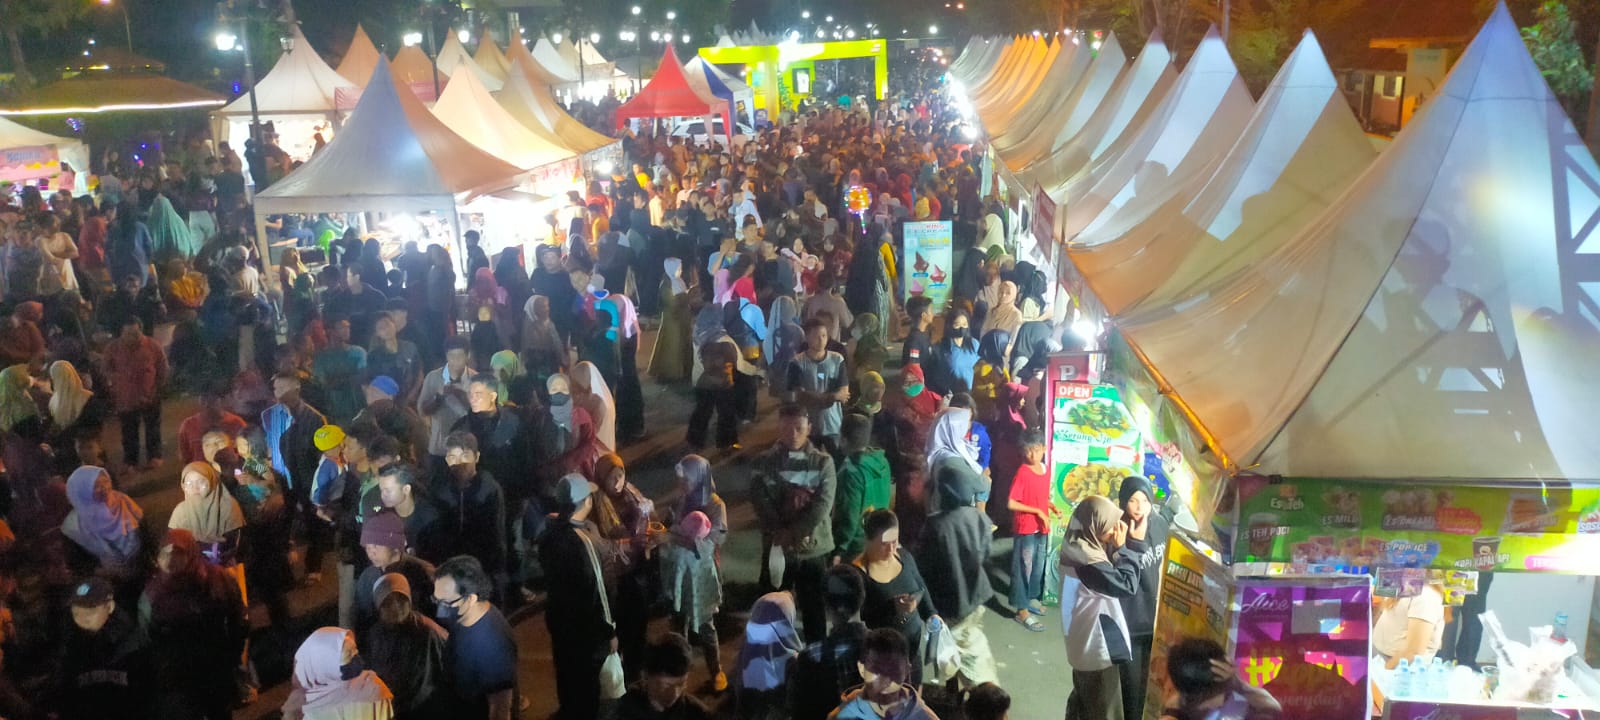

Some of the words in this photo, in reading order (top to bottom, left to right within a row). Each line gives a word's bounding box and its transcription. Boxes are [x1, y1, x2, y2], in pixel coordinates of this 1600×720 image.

[1059, 365, 1076, 381] P
[1059, 386, 1090, 398] OPEN
[1281, 690, 1343, 711] veryday
